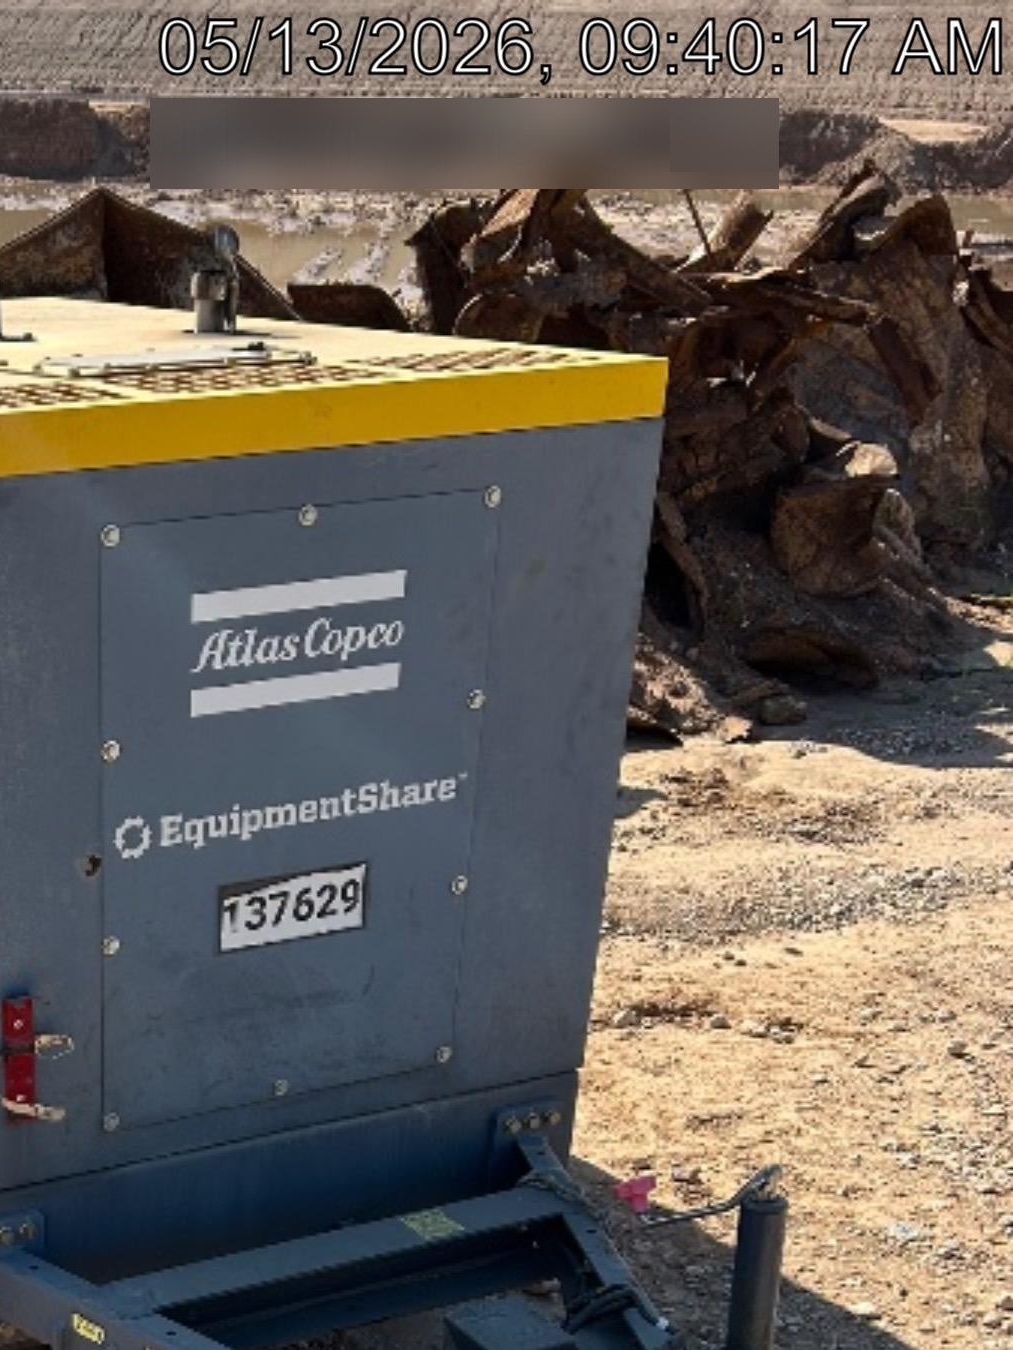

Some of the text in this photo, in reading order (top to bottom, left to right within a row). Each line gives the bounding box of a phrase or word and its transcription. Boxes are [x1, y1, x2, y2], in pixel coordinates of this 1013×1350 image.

[190, 616, 404, 673] Atlas Copco
[159, 775, 457, 850] EquipmentShare
[222, 879, 362, 935] 137629
